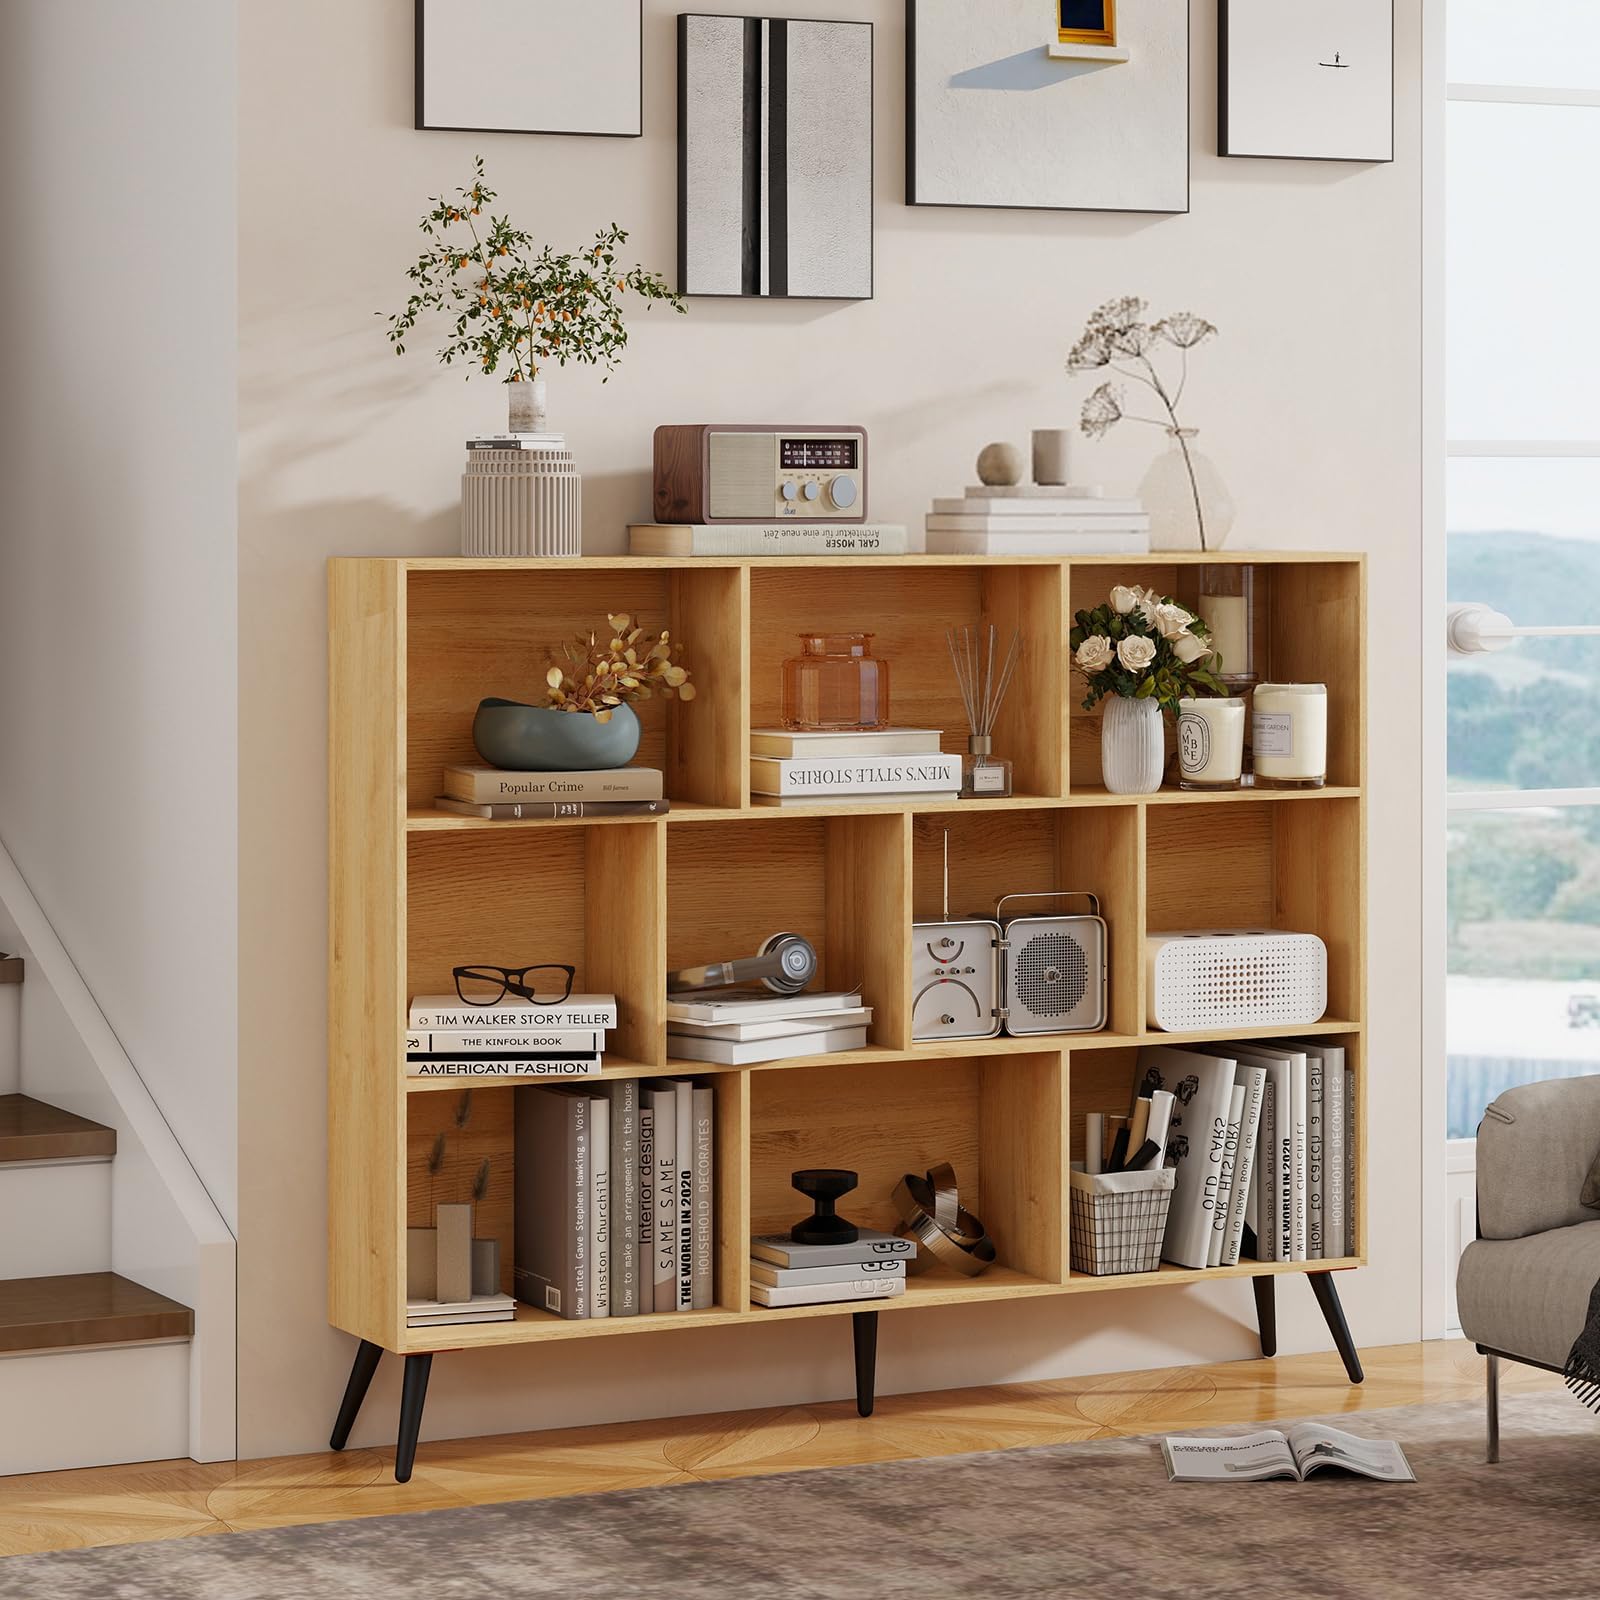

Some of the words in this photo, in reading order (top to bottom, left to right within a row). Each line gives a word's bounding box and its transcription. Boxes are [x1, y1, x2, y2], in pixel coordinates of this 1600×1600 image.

[764, 530, 779, 539] Zeit
[782, 530, 801, 538] neue
[803, 530, 820, 538] eine
[822, 530, 834, 539] für
[825, 539, 855, 548] MOSER
[836, 530, 879, 539] Architektur
[858, 539, 880, 548] CARL
[789, 769, 852, 786] STORIES
[856, 767, 902, 783] STYLE
[500, 782, 545, 795] Popular
[549, 781, 584, 792] Crime
[436, 1015, 457, 1025] TIM
[462, 1015, 516, 1025] WALKER
[521, 1014, 562, 1025] STORY
[567, 1014, 610, 1024] TELLER
[462, 1038, 481, 1046] THE
[486, 1038, 530, 1046] KINFOLK
[534, 1038, 562, 1046] BOOK
[418, 1064, 508, 1074] AMERICAN
[514, 1062, 588, 1074] FASHION
[624, 1083, 632, 1112] house
[575, 1102, 584, 1130] Voice
[624, 1117, 632, 1134] the
[623, 1140, 632, 1152] in
[639, 1116, 654, 1176] design
[698, 1119, 710, 1193] DECORATES
[1282, 1138, 1290, 1170] 2020
[575, 1147, 586, 1186] Hawking
[624, 1158, 634, 1220] arrangement
[660, 1159, 674, 1208] SAME
[681, 1171, 692, 1206] 2020
[1282, 1173, 1290, 1186] IN
[575, 1191, 586, 1231] Stephen
[597, 1171, 608, 1243] Churchill
[639, 1182, 652, 1244] Interior
[681, 1210, 692, 1224] IN
[626, 1226, 632, 1238] an
[698, 1200, 710, 1276] HOUSEHOLD
[576, 1236, 584, 1260] Gave
[660, 1220, 674, 1269] SAME
[681, 1228, 692, 1276] WORLD
[1282, 1234, 1290, 1257] THE
[624, 1244, 632, 1267] make
[575, 1265, 584, 1292] Intel
[597, 1251, 608, 1308] Winston
[624, 1272, 632, 1284] to
[624, 1290, 632, 1308] How
[681, 1280, 692, 1305] THE
[576, 1297, 584, 1315] How
